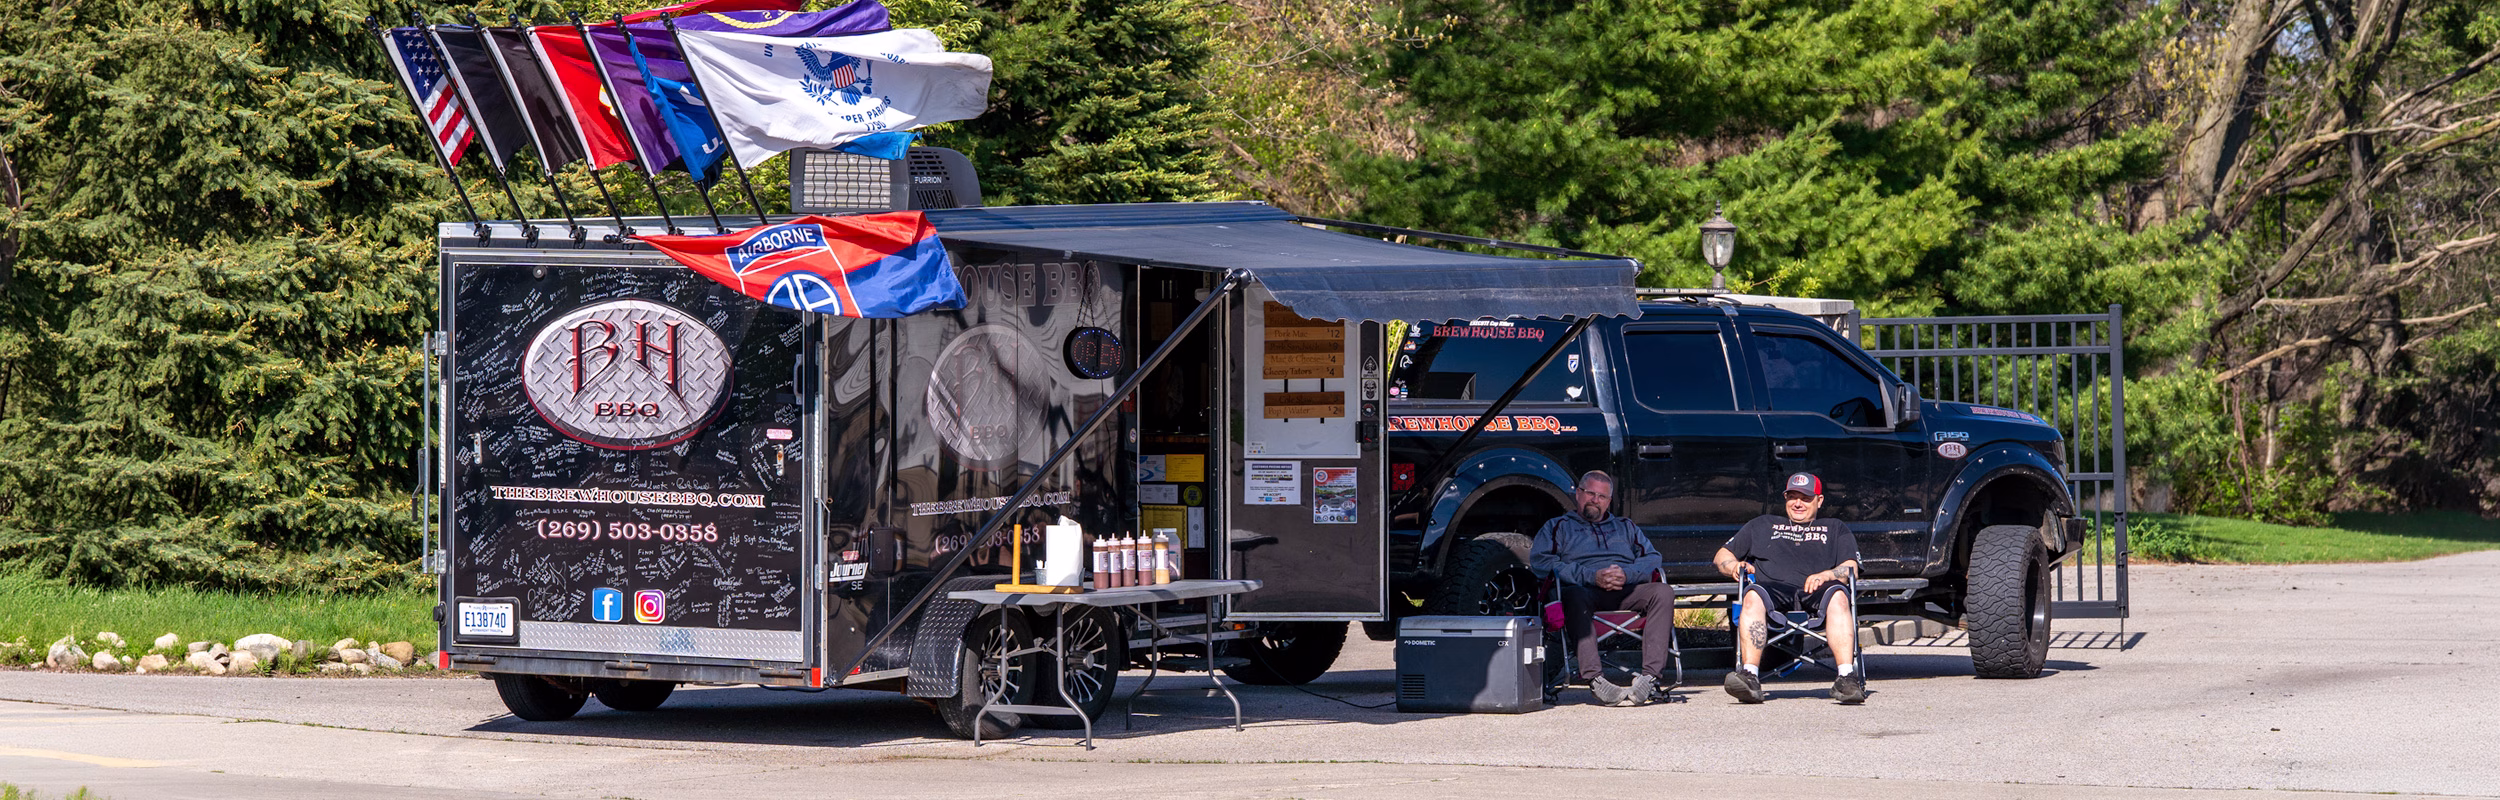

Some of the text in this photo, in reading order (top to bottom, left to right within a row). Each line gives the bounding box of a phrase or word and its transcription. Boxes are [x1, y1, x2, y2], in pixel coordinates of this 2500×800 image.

[914, 176, 942, 184] FURRION
[737, 228, 817, 265] AIRBORNE
[1042, 260, 1101, 310] BBQ
[1274, 328, 1340, 338] Pork Mac $12
[1433, 325, 1545, 342] BREWHOUSE BBQ
[1073, 340, 1122, 368] OPEN
[1271, 355, 1286, 363] Mac
[1295, 353, 1322, 363] Cheese
[1328, 354, 1337, 363] $4
[567, 318, 690, 415] BH
[1263, 367, 1288, 376] Cheesy
[1326, 367, 1335, 376] $4
[594, 402, 661, 419] BBQ
[1268, 407, 1281, 417] Pop
[1287, 406, 1310, 414] Water
[970, 425, 1007, 440] BBQ
[1388, 415, 1513, 432] REWHOUSE
[1514, 416, 1561, 434] BBQ
[490, 485, 766, 508] THEBREWHOUSEBBQ.COM
[537, 518, 719, 543] (269) 503-0358
[1804, 532, 1828, 544] BBQ
[830, 562, 869, 579] Journey
[851, 581, 864, 590] SE
[465, 611, 507, 629] E138740
